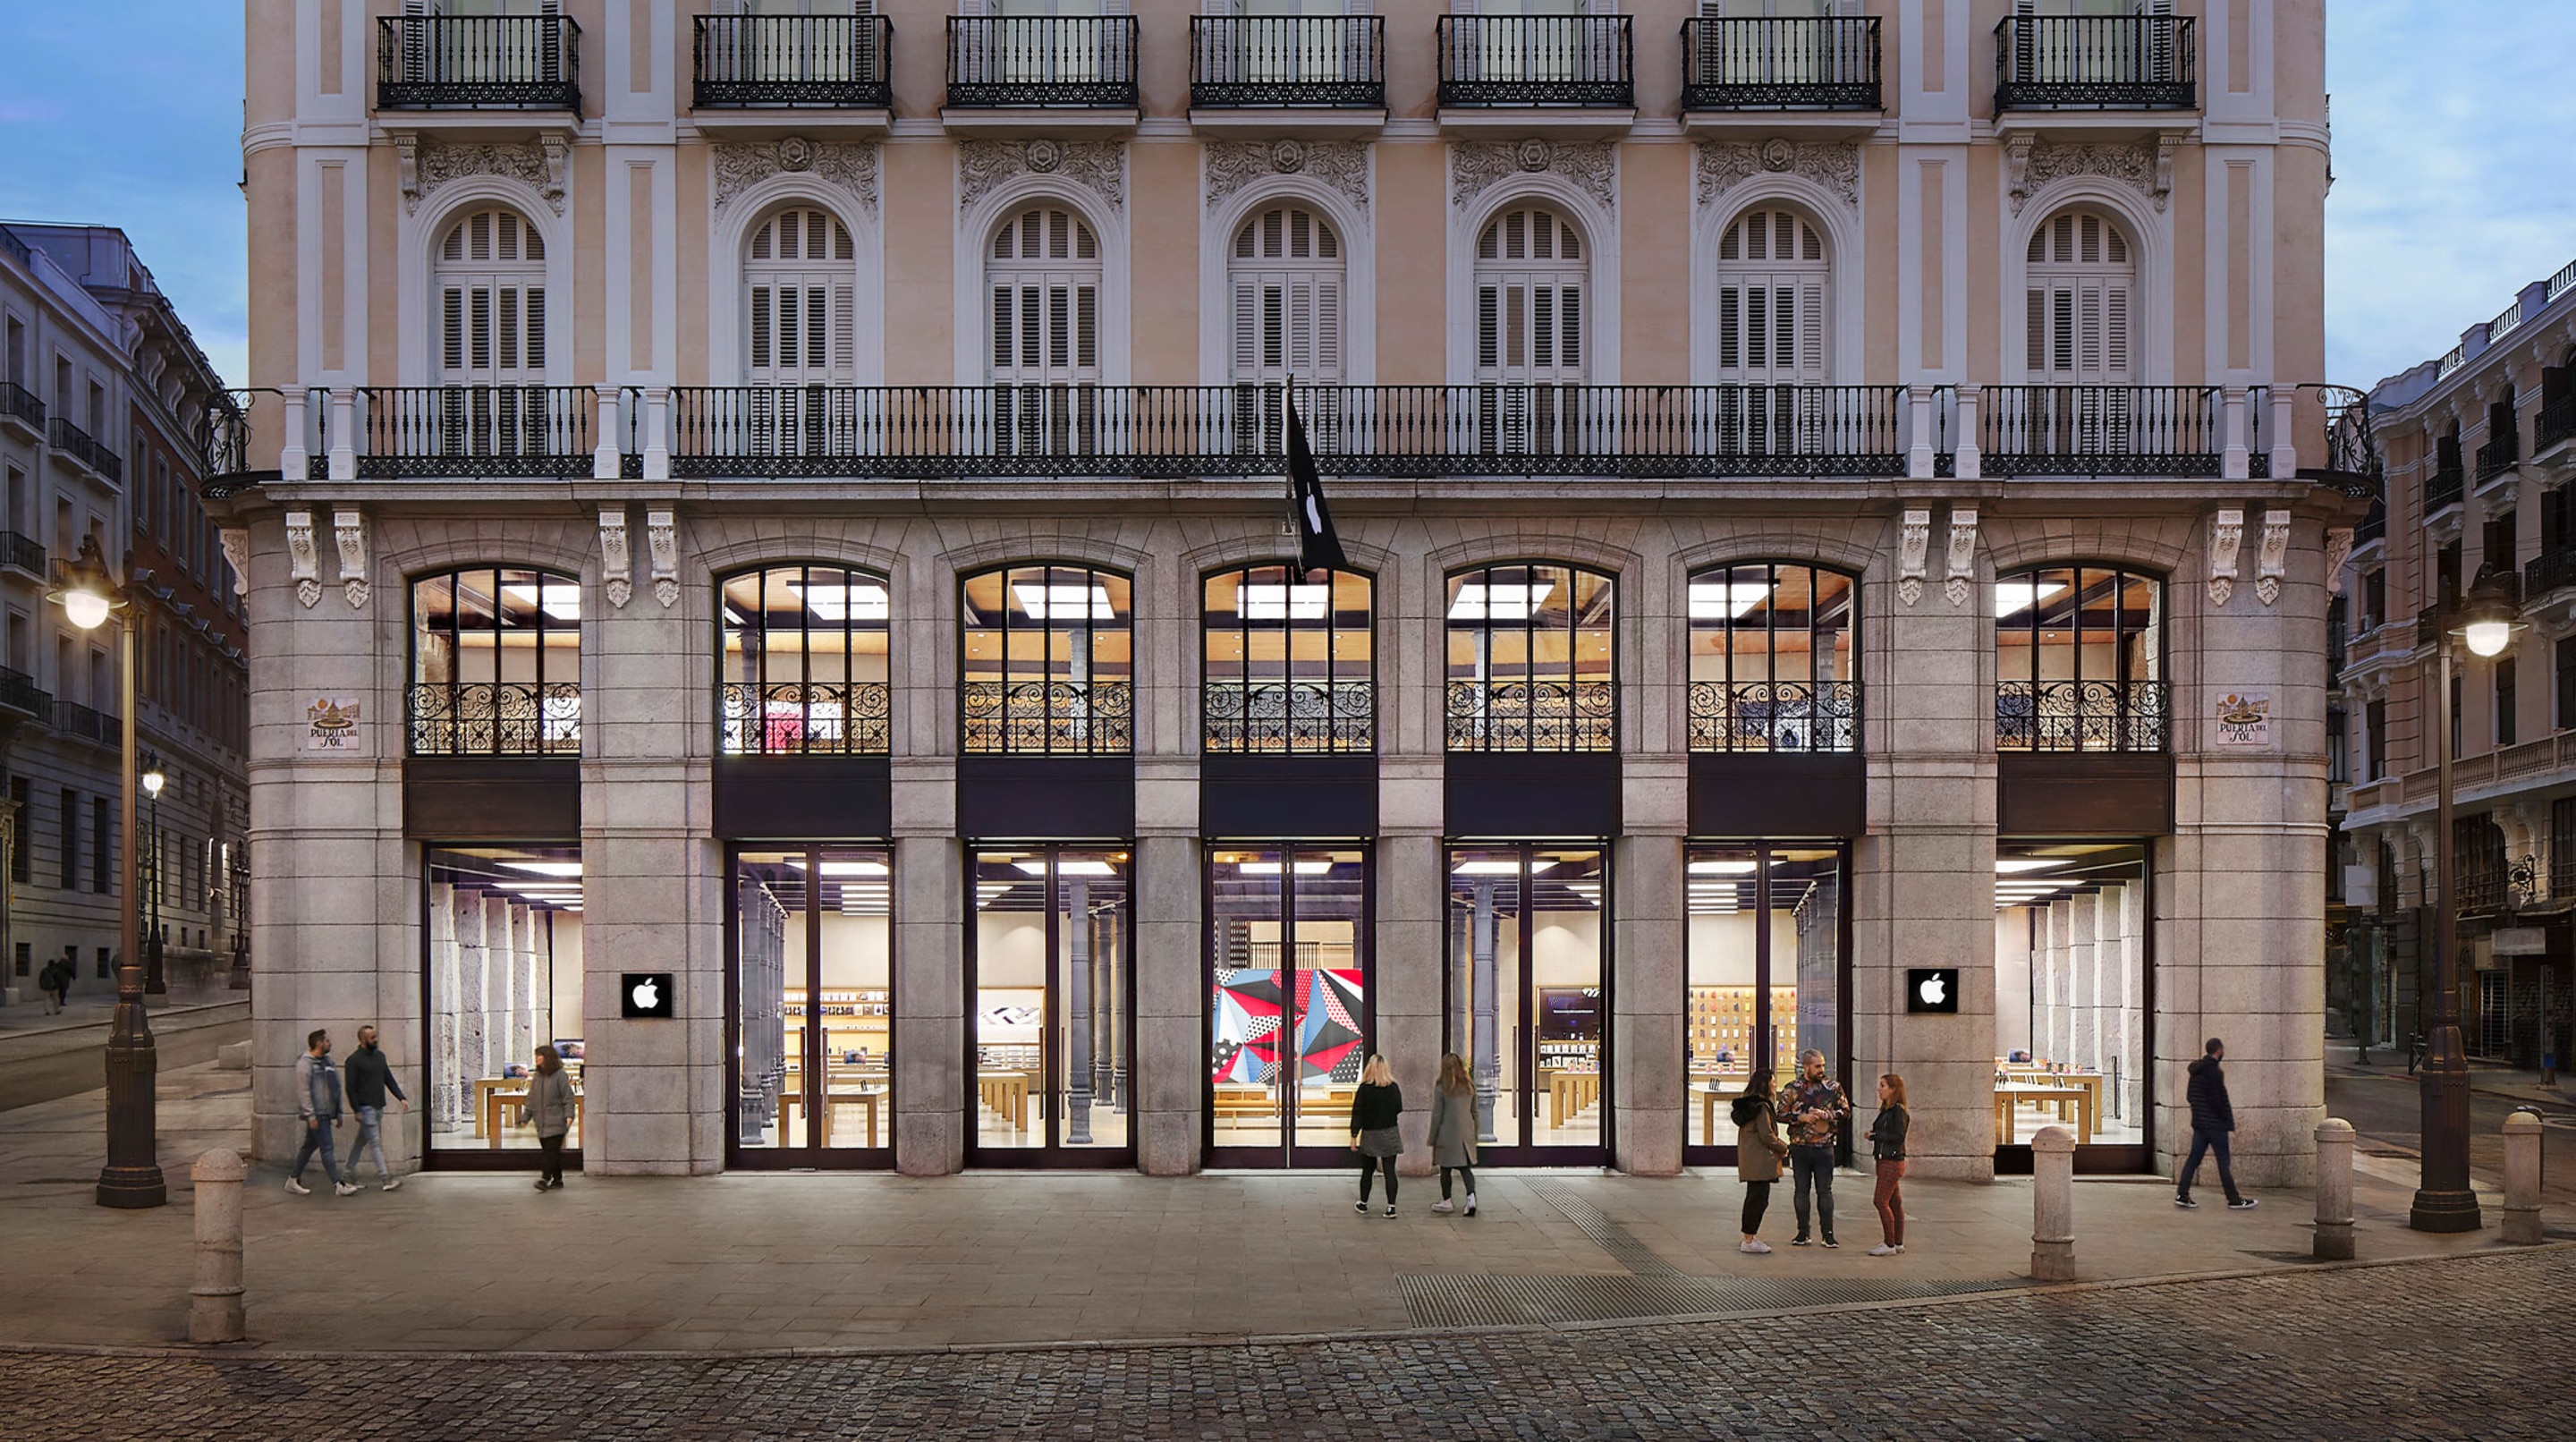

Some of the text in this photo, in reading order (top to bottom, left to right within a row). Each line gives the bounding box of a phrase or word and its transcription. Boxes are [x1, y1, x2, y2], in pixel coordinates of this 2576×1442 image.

[310, 728, 346, 737] PUERTA
[2220, 724, 2255, 732] PUERTA
[320, 736, 343, 747] SOL
[2229, 731, 2252, 742] SOL
